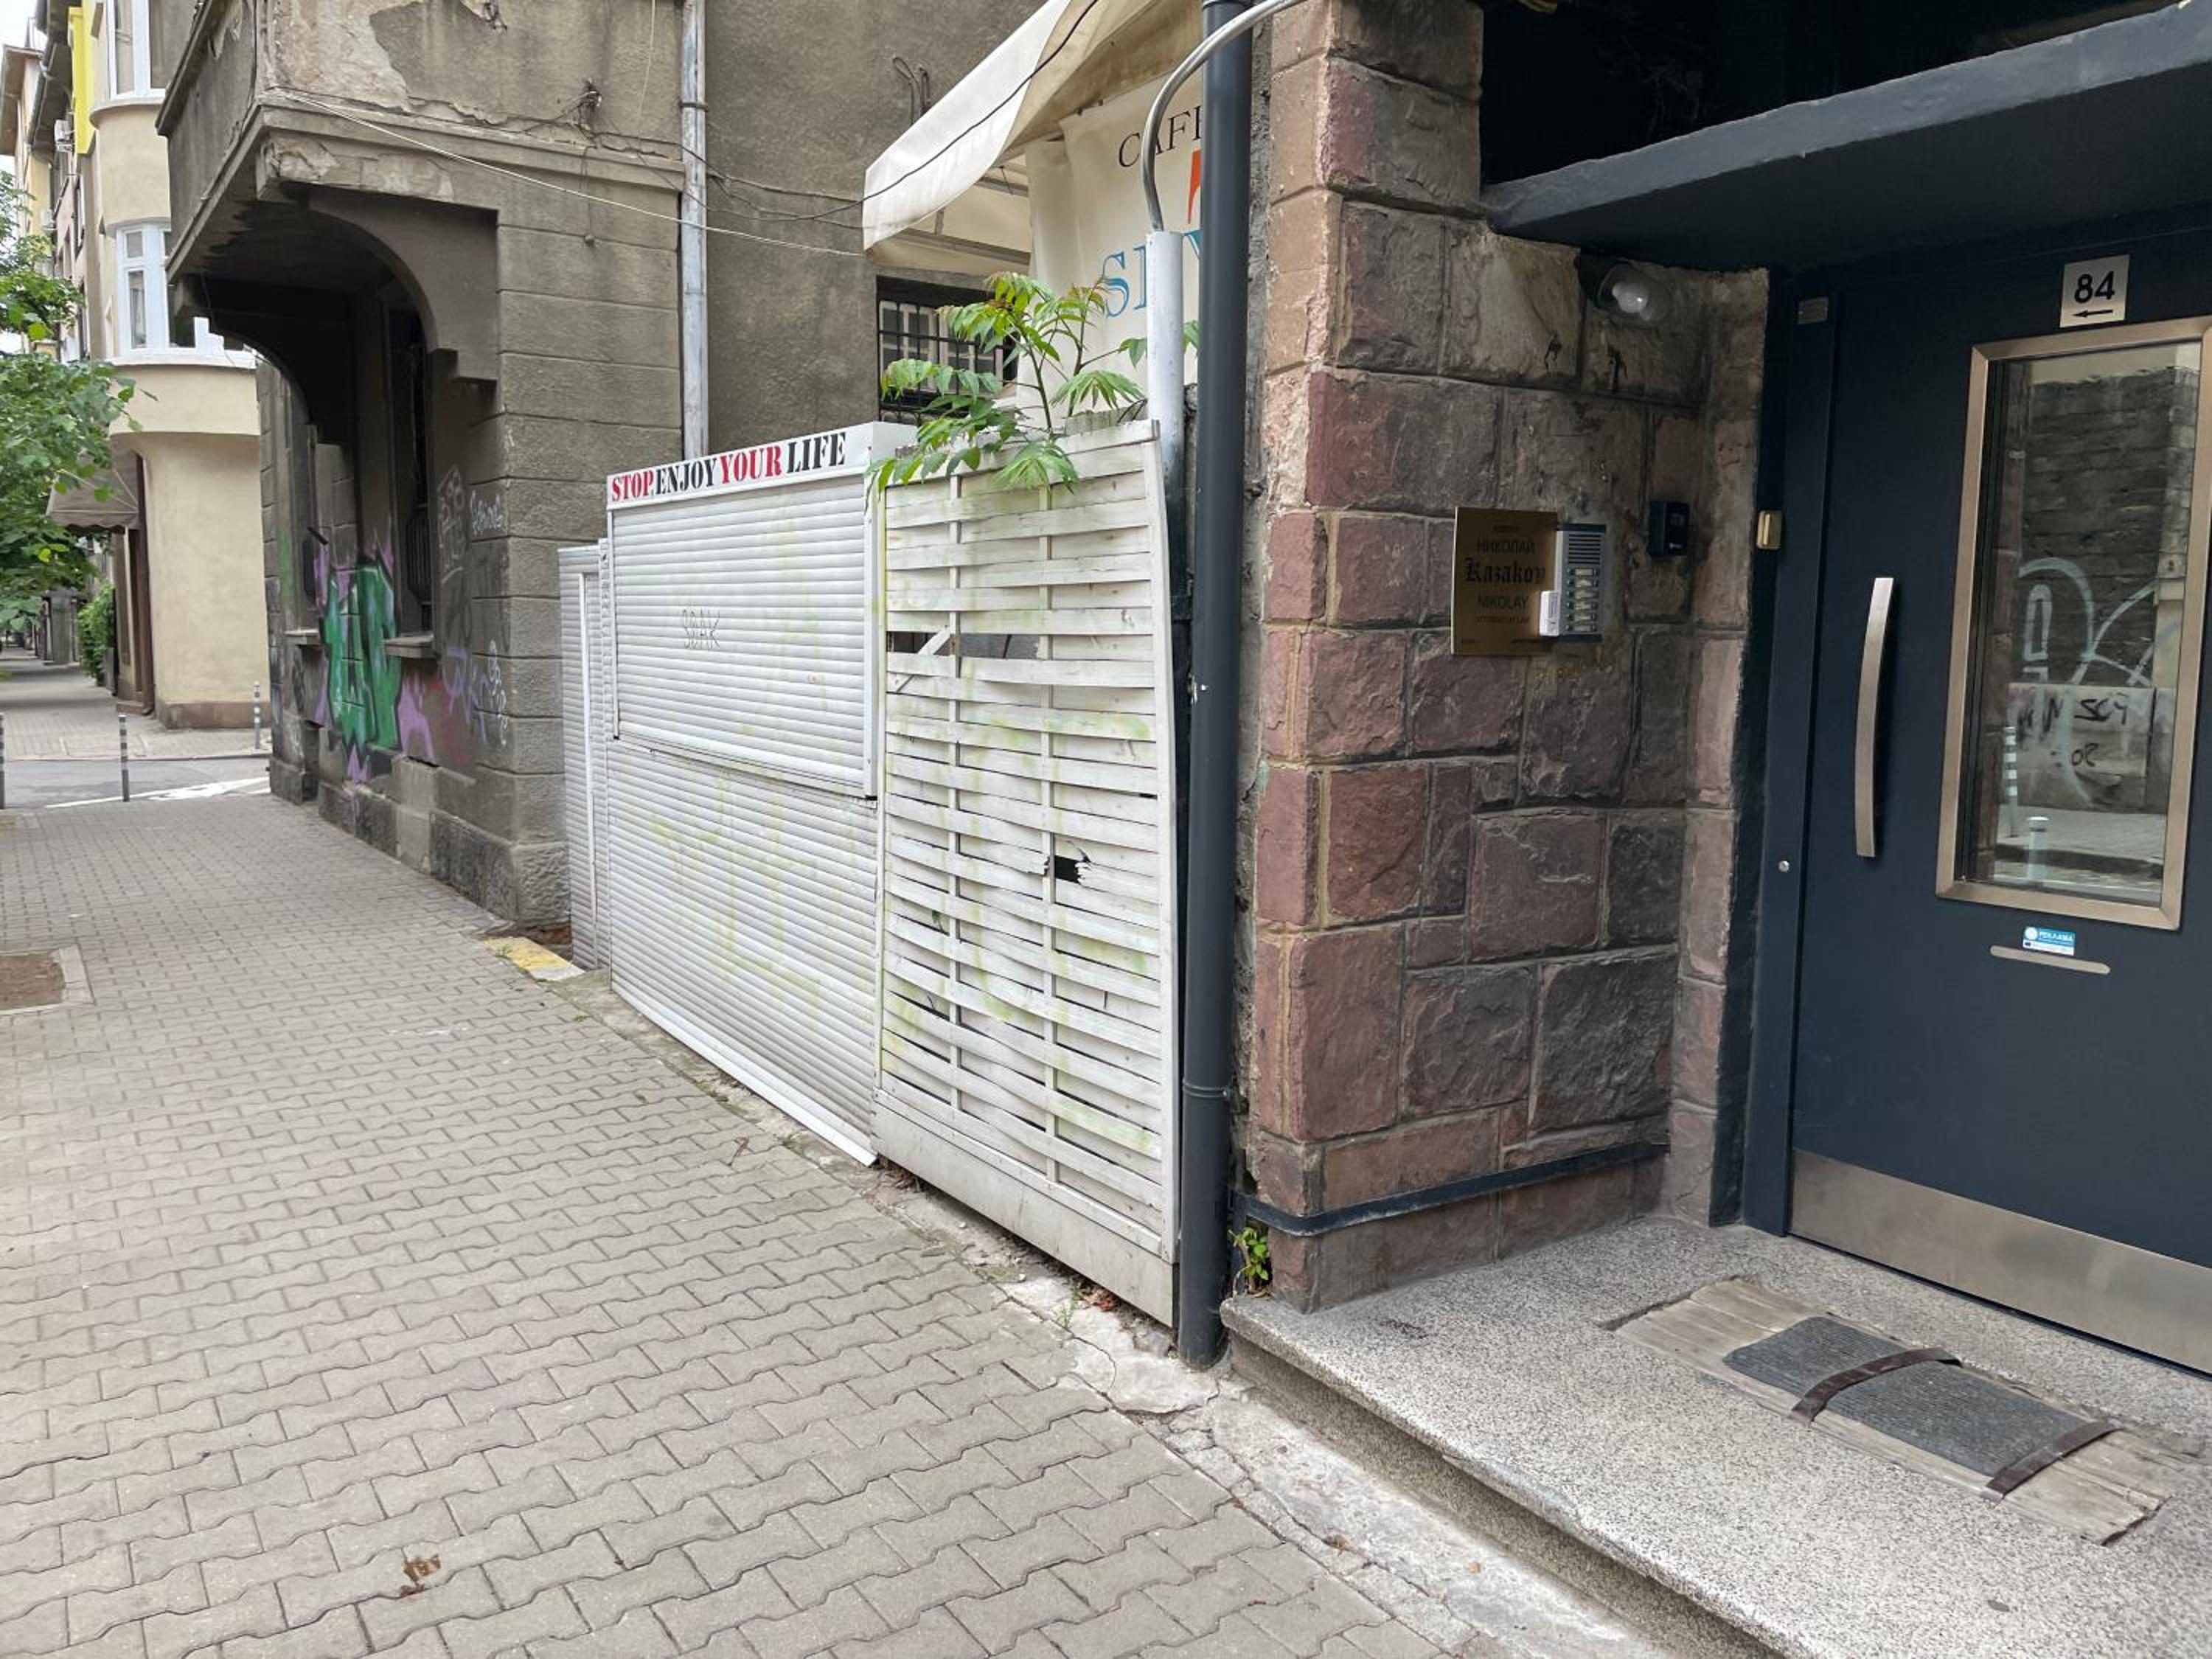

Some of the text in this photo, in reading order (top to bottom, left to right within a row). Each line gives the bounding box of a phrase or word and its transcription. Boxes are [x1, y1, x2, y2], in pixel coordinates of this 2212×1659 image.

[2074, 271, 2115, 303] 84
[655, 457, 717, 495] ENJOY
[720, 444, 782, 485] YOUR
[787, 431, 846, 474] LIFE
[1477, 594, 1529, 611] NIKOLAY
